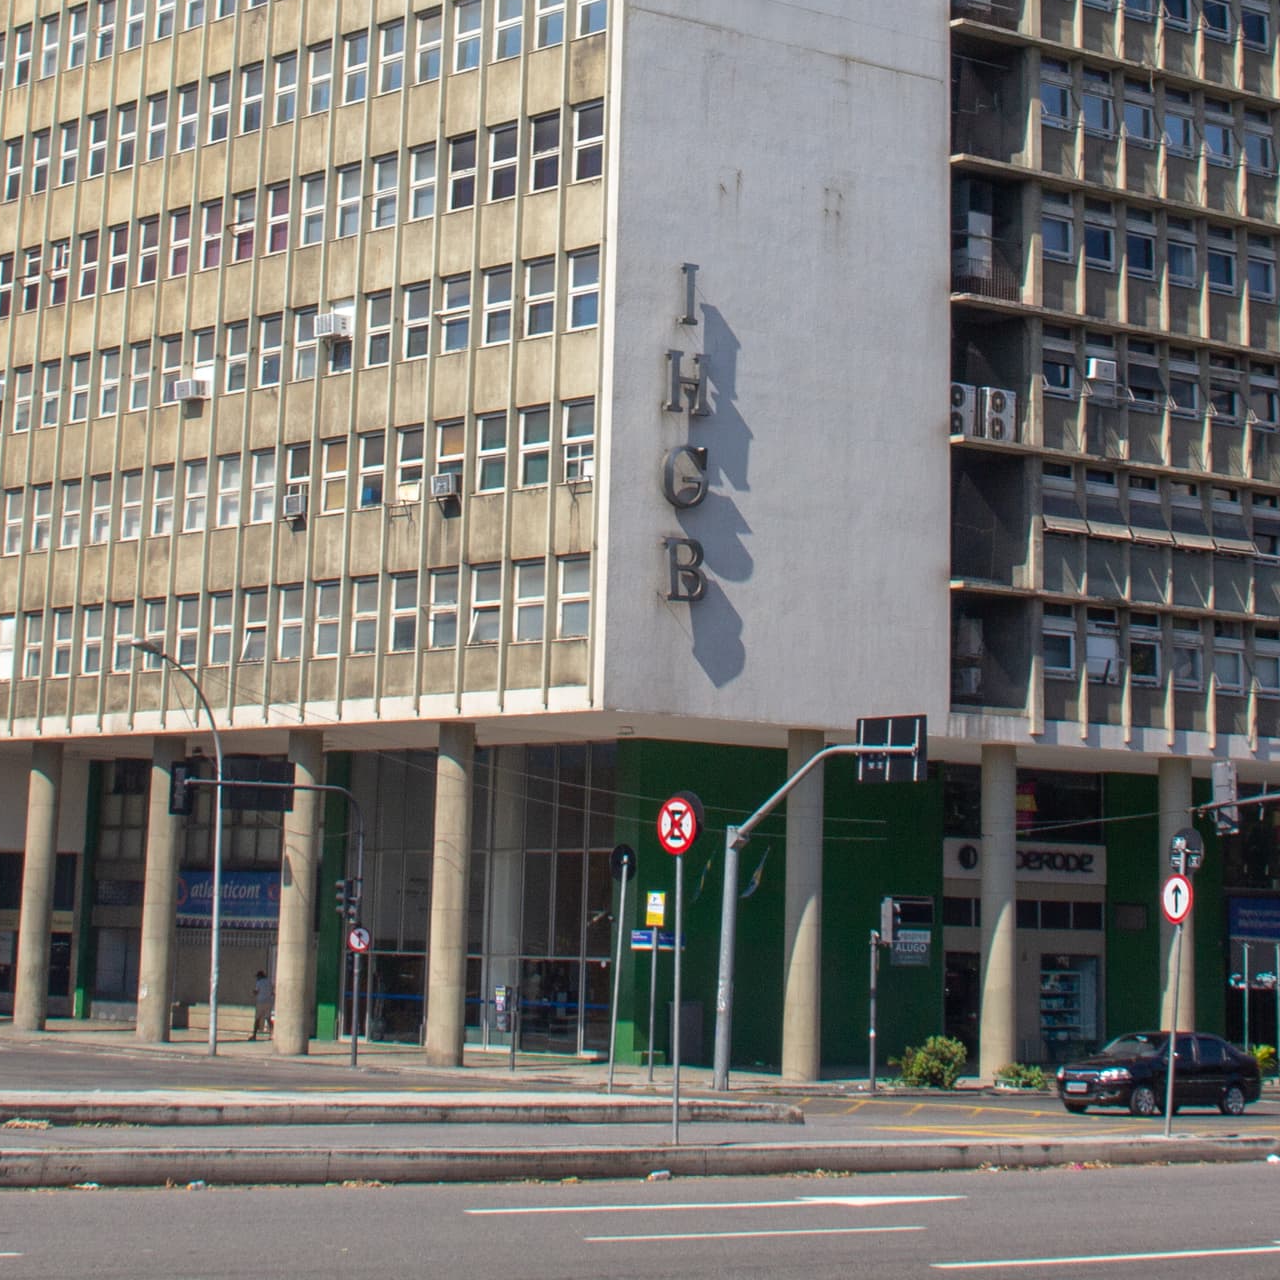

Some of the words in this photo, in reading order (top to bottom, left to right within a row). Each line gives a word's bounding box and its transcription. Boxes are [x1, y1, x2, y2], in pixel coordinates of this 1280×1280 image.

[662, 262, 710, 602] IHGB
[190, 879, 262, 900] atlaticont
[895, 942, 928, 954] ALUGO
